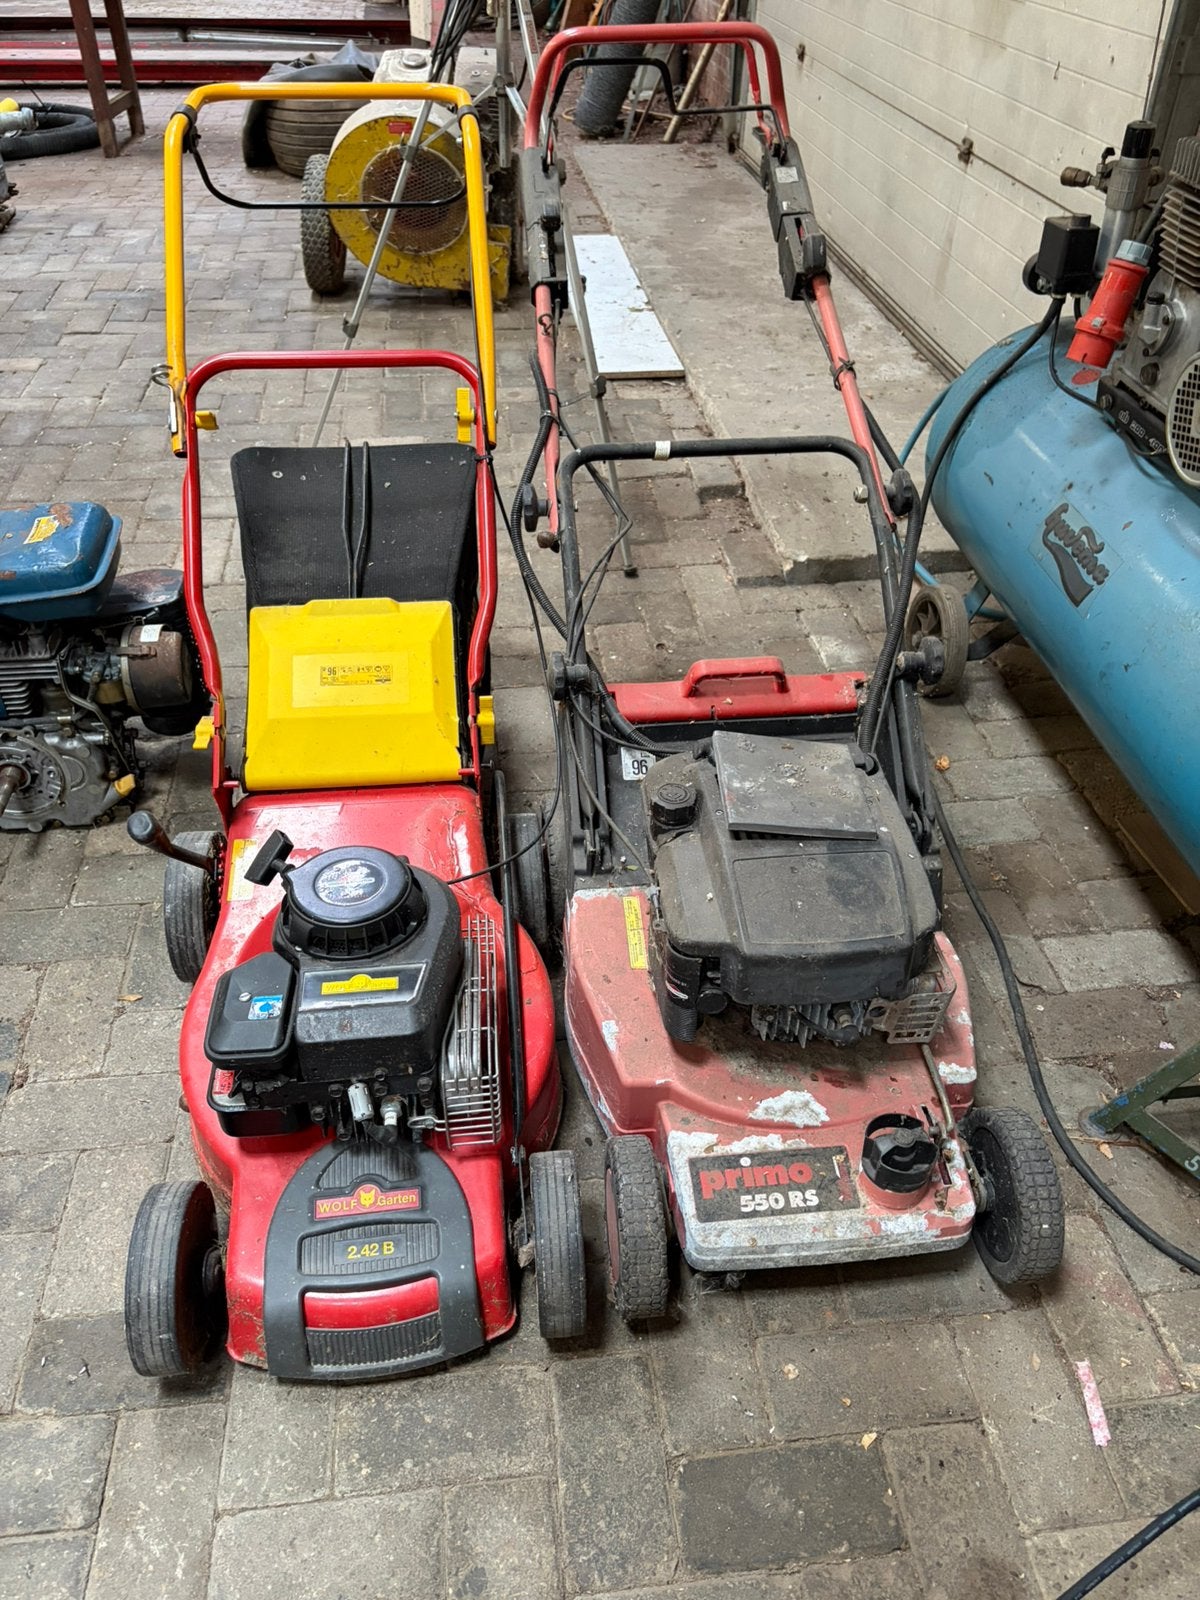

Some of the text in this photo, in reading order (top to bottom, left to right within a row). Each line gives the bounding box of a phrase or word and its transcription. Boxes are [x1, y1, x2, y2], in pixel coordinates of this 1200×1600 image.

[327, 665, 336, 676] 96
[631, 759, 649, 776] 96
[700, 1156, 812, 1199] primo
[318, 1193, 416, 1212] WOLF Garten
[740, 1188, 820, 1213] 550 RS
[347, 1240, 394, 1260] 2.42 B
